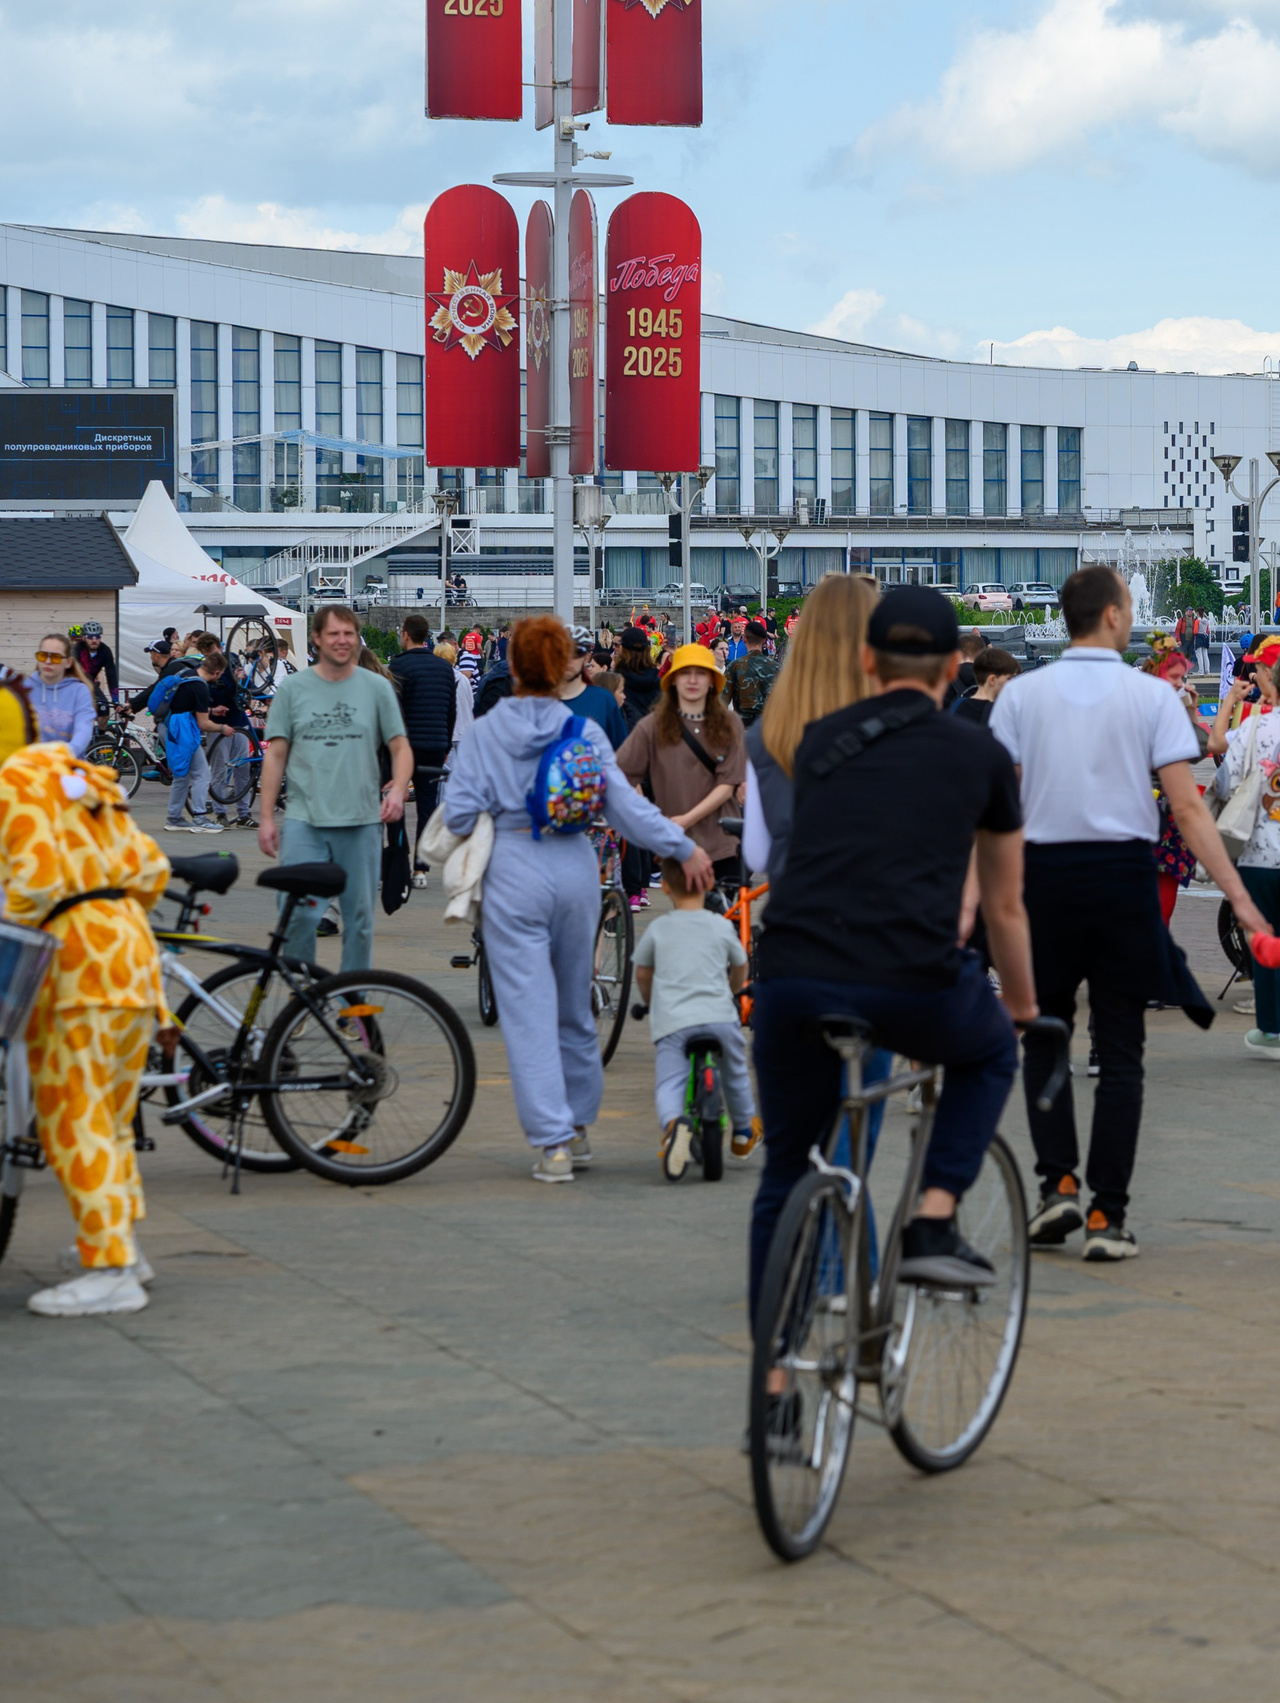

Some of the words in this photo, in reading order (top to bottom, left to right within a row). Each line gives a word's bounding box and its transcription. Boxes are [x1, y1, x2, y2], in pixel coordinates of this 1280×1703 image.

[610, 254, 699, 301] Победа
[451, 287, 491, 329] ОТЕЧЕСТВЕННАЯ
[481, 303, 495, 330] ВОЙНА
[573, 308, 588, 338] 1945
[627, 307, 682, 338] 1945
[572, 349, 588, 377] 2025
[623, 346, 682, 377] 2025
[4, 443, 103, 452] полупроводниковых
[105, 443, 152, 452] приборов
[94, 433, 152, 443] Дискретных
